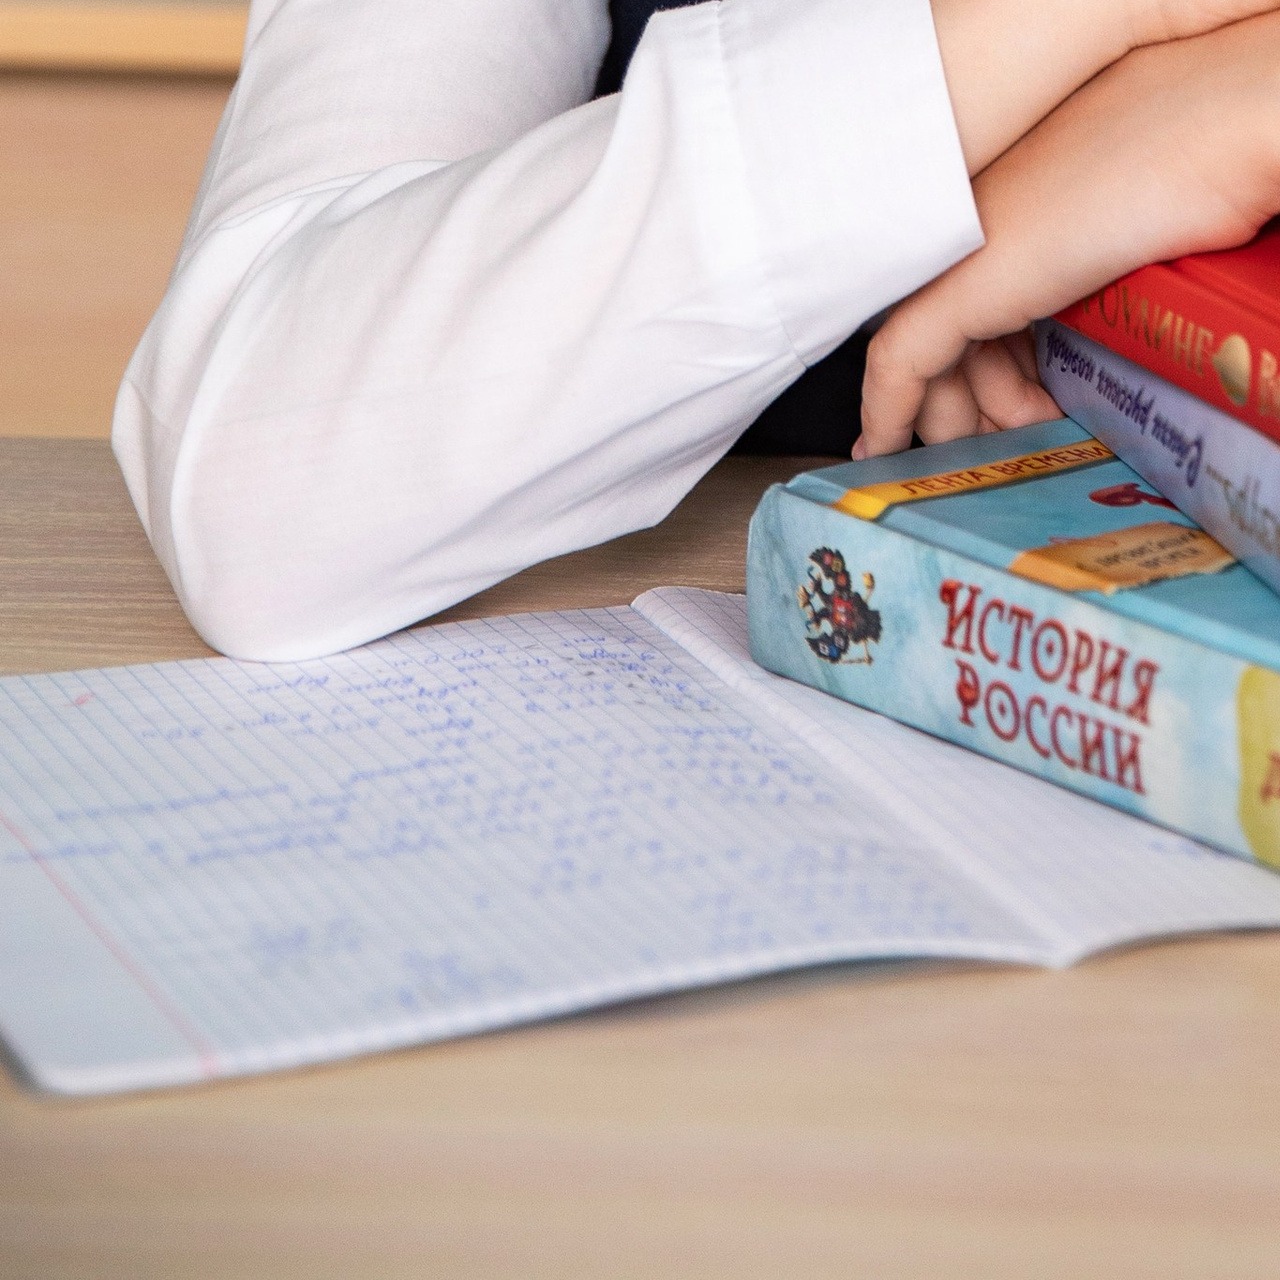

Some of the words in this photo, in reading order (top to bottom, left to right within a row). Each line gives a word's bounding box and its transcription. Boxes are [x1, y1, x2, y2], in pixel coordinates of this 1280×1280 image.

[1083, 283, 1213, 375] ОУЛИНГ
[900, 469, 991, 496] ЛЕНТА
[989, 445, 1114, 476] ВРЕМЕНИ
[939, 578, 1160, 728] ИСТОРИЯ
[954, 658, 1147, 796] РОССИИ
